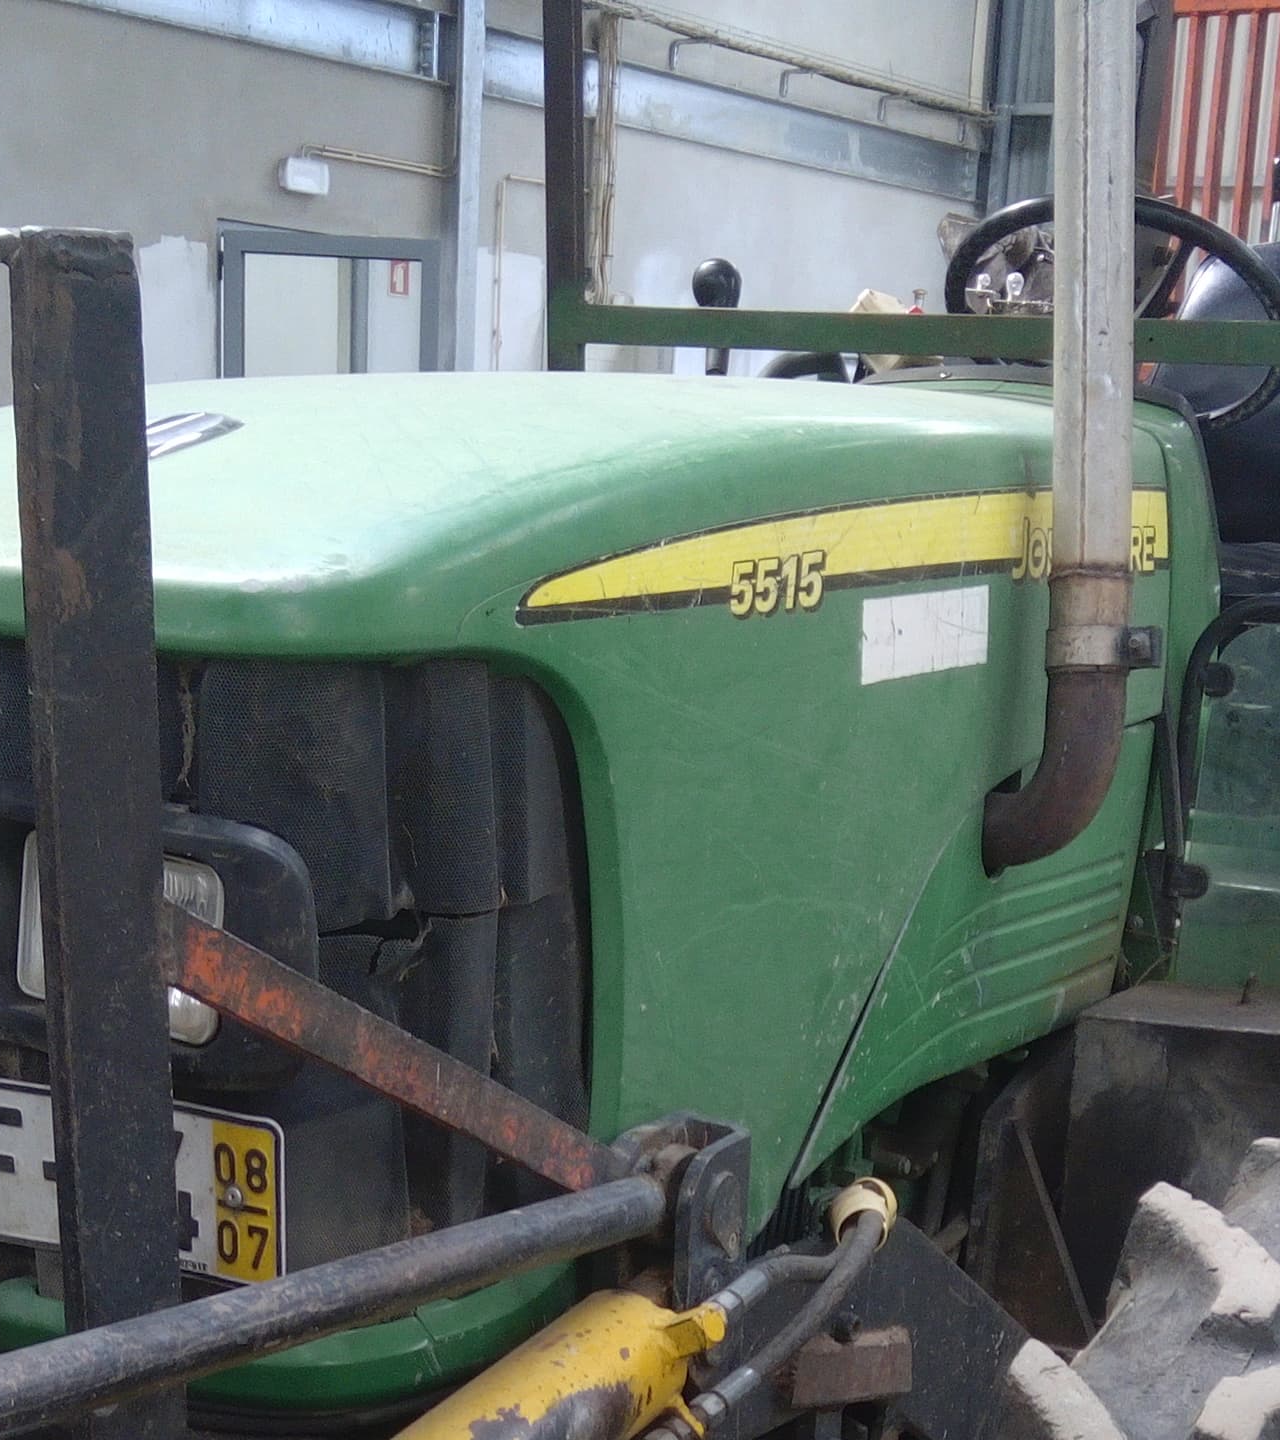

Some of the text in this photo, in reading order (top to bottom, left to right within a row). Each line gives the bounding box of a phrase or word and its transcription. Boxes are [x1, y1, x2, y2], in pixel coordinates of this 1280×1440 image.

[729, 548, 827, 620] 5515
[214, 1142, 268, 1195] 08
[217, 1219, 269, 1271] 07
